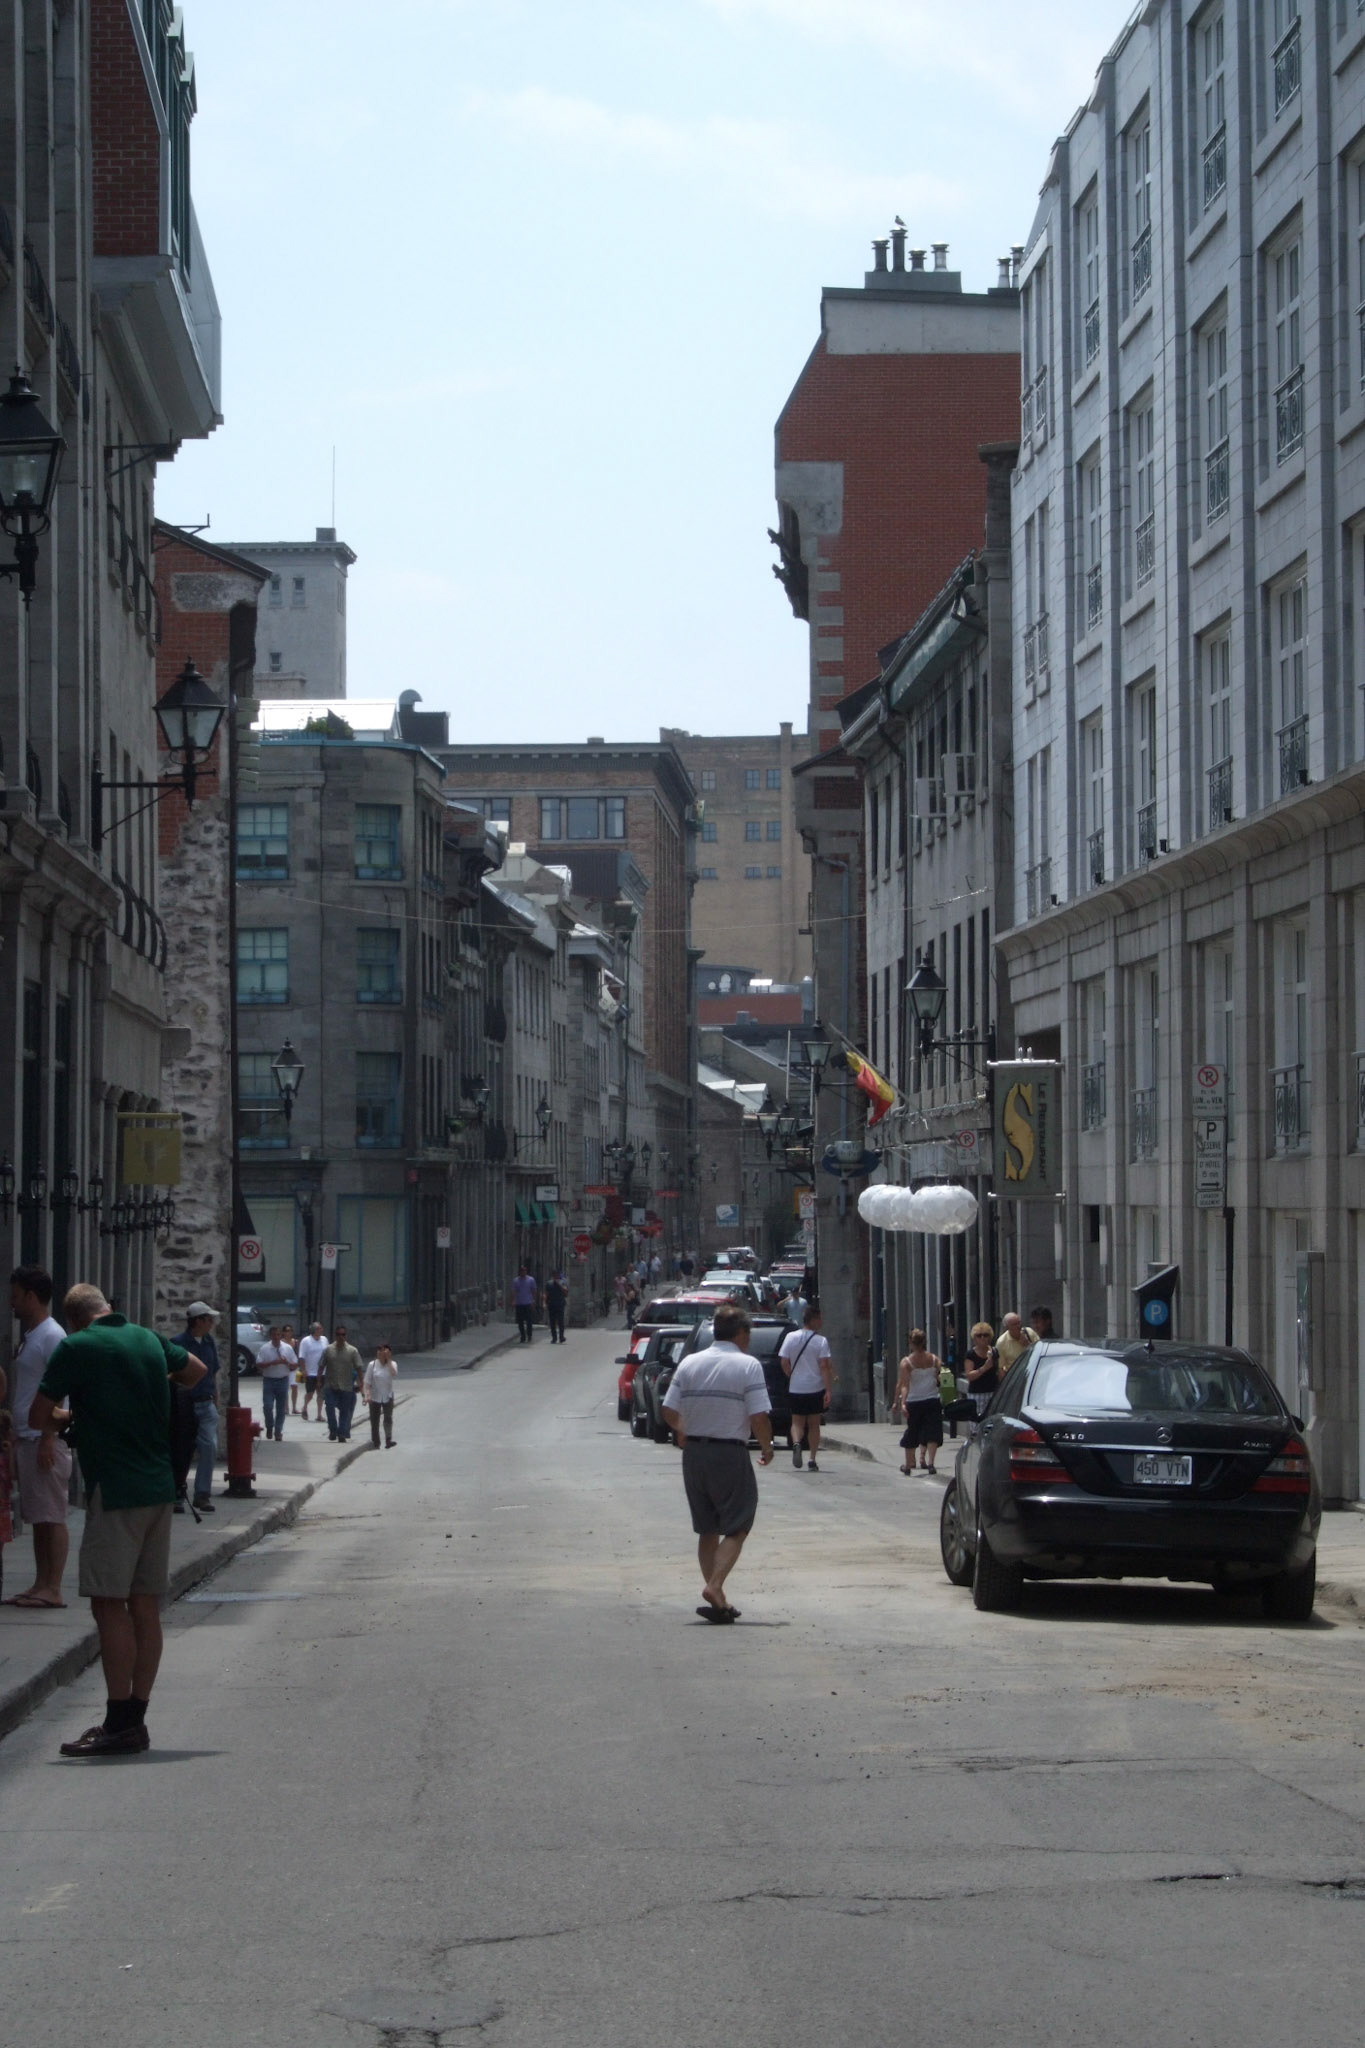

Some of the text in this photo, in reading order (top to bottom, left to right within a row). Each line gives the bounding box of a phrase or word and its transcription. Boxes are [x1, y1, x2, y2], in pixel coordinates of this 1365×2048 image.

[1003, 1082, 1034, 1181] S
[1207, 1122, 1217, 1140] P
[1038, 1103, 1047, 1179] RESTAURANT
[1152, 1304, 1162, 1320] P
[1137, 1461, 1190, 1477] 450 VTN
